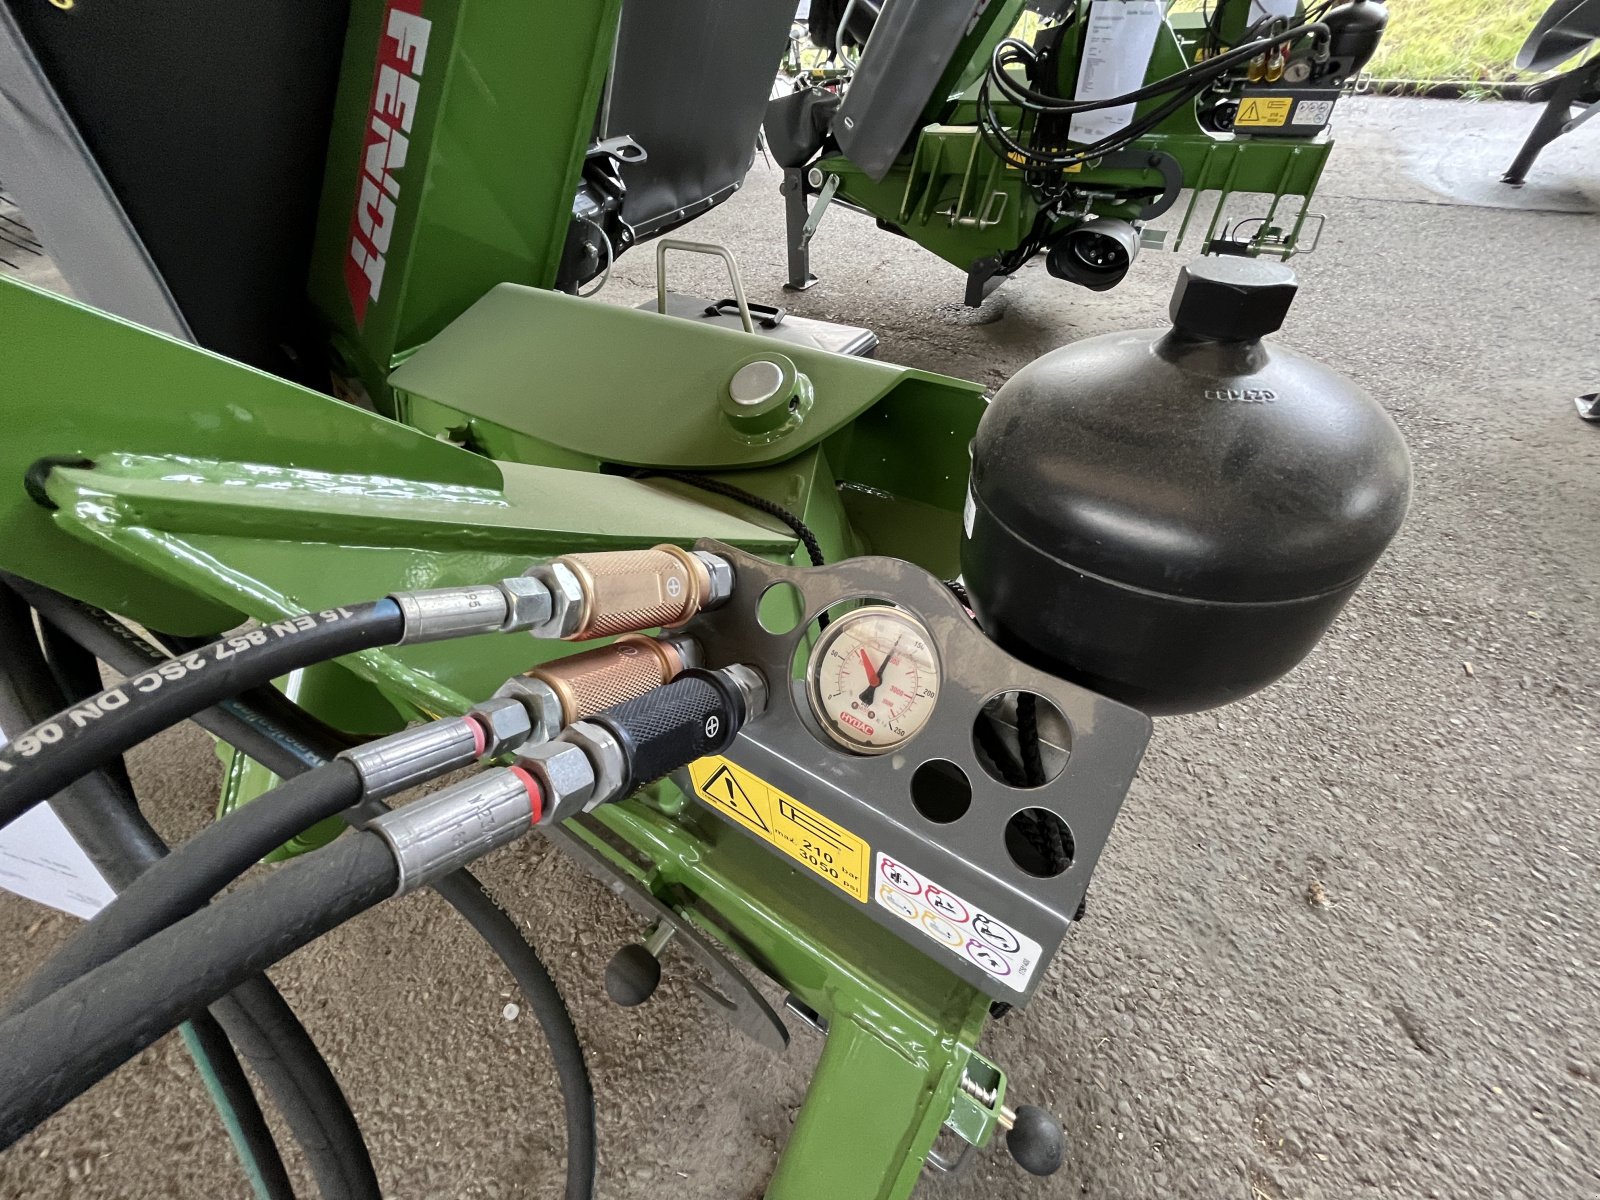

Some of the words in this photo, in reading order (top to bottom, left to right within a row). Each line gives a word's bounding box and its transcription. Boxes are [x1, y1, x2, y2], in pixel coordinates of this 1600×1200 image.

[351, 8, 432, 304] FENDT
[271, 616, 318, 637] EN
[319, 607, 353, 623] 15
[215, 630, 268, 660] 857
[830, 649, 839, 658] 50
[133, 653, 206, 692] 2SC
[68, 688, 130, 727] DN
[922, 688, 936, 699] 200
[841, 711, 875, 736] HYDAC
[893, 726, 906, 738] 250
[13, 722, 64, 757] 06
[799, 848, 839, 880] 3050
[843, 880, 859, 893] psi
[802, 839, 834, 864] 210
[841, 866, 859, 881] bar
